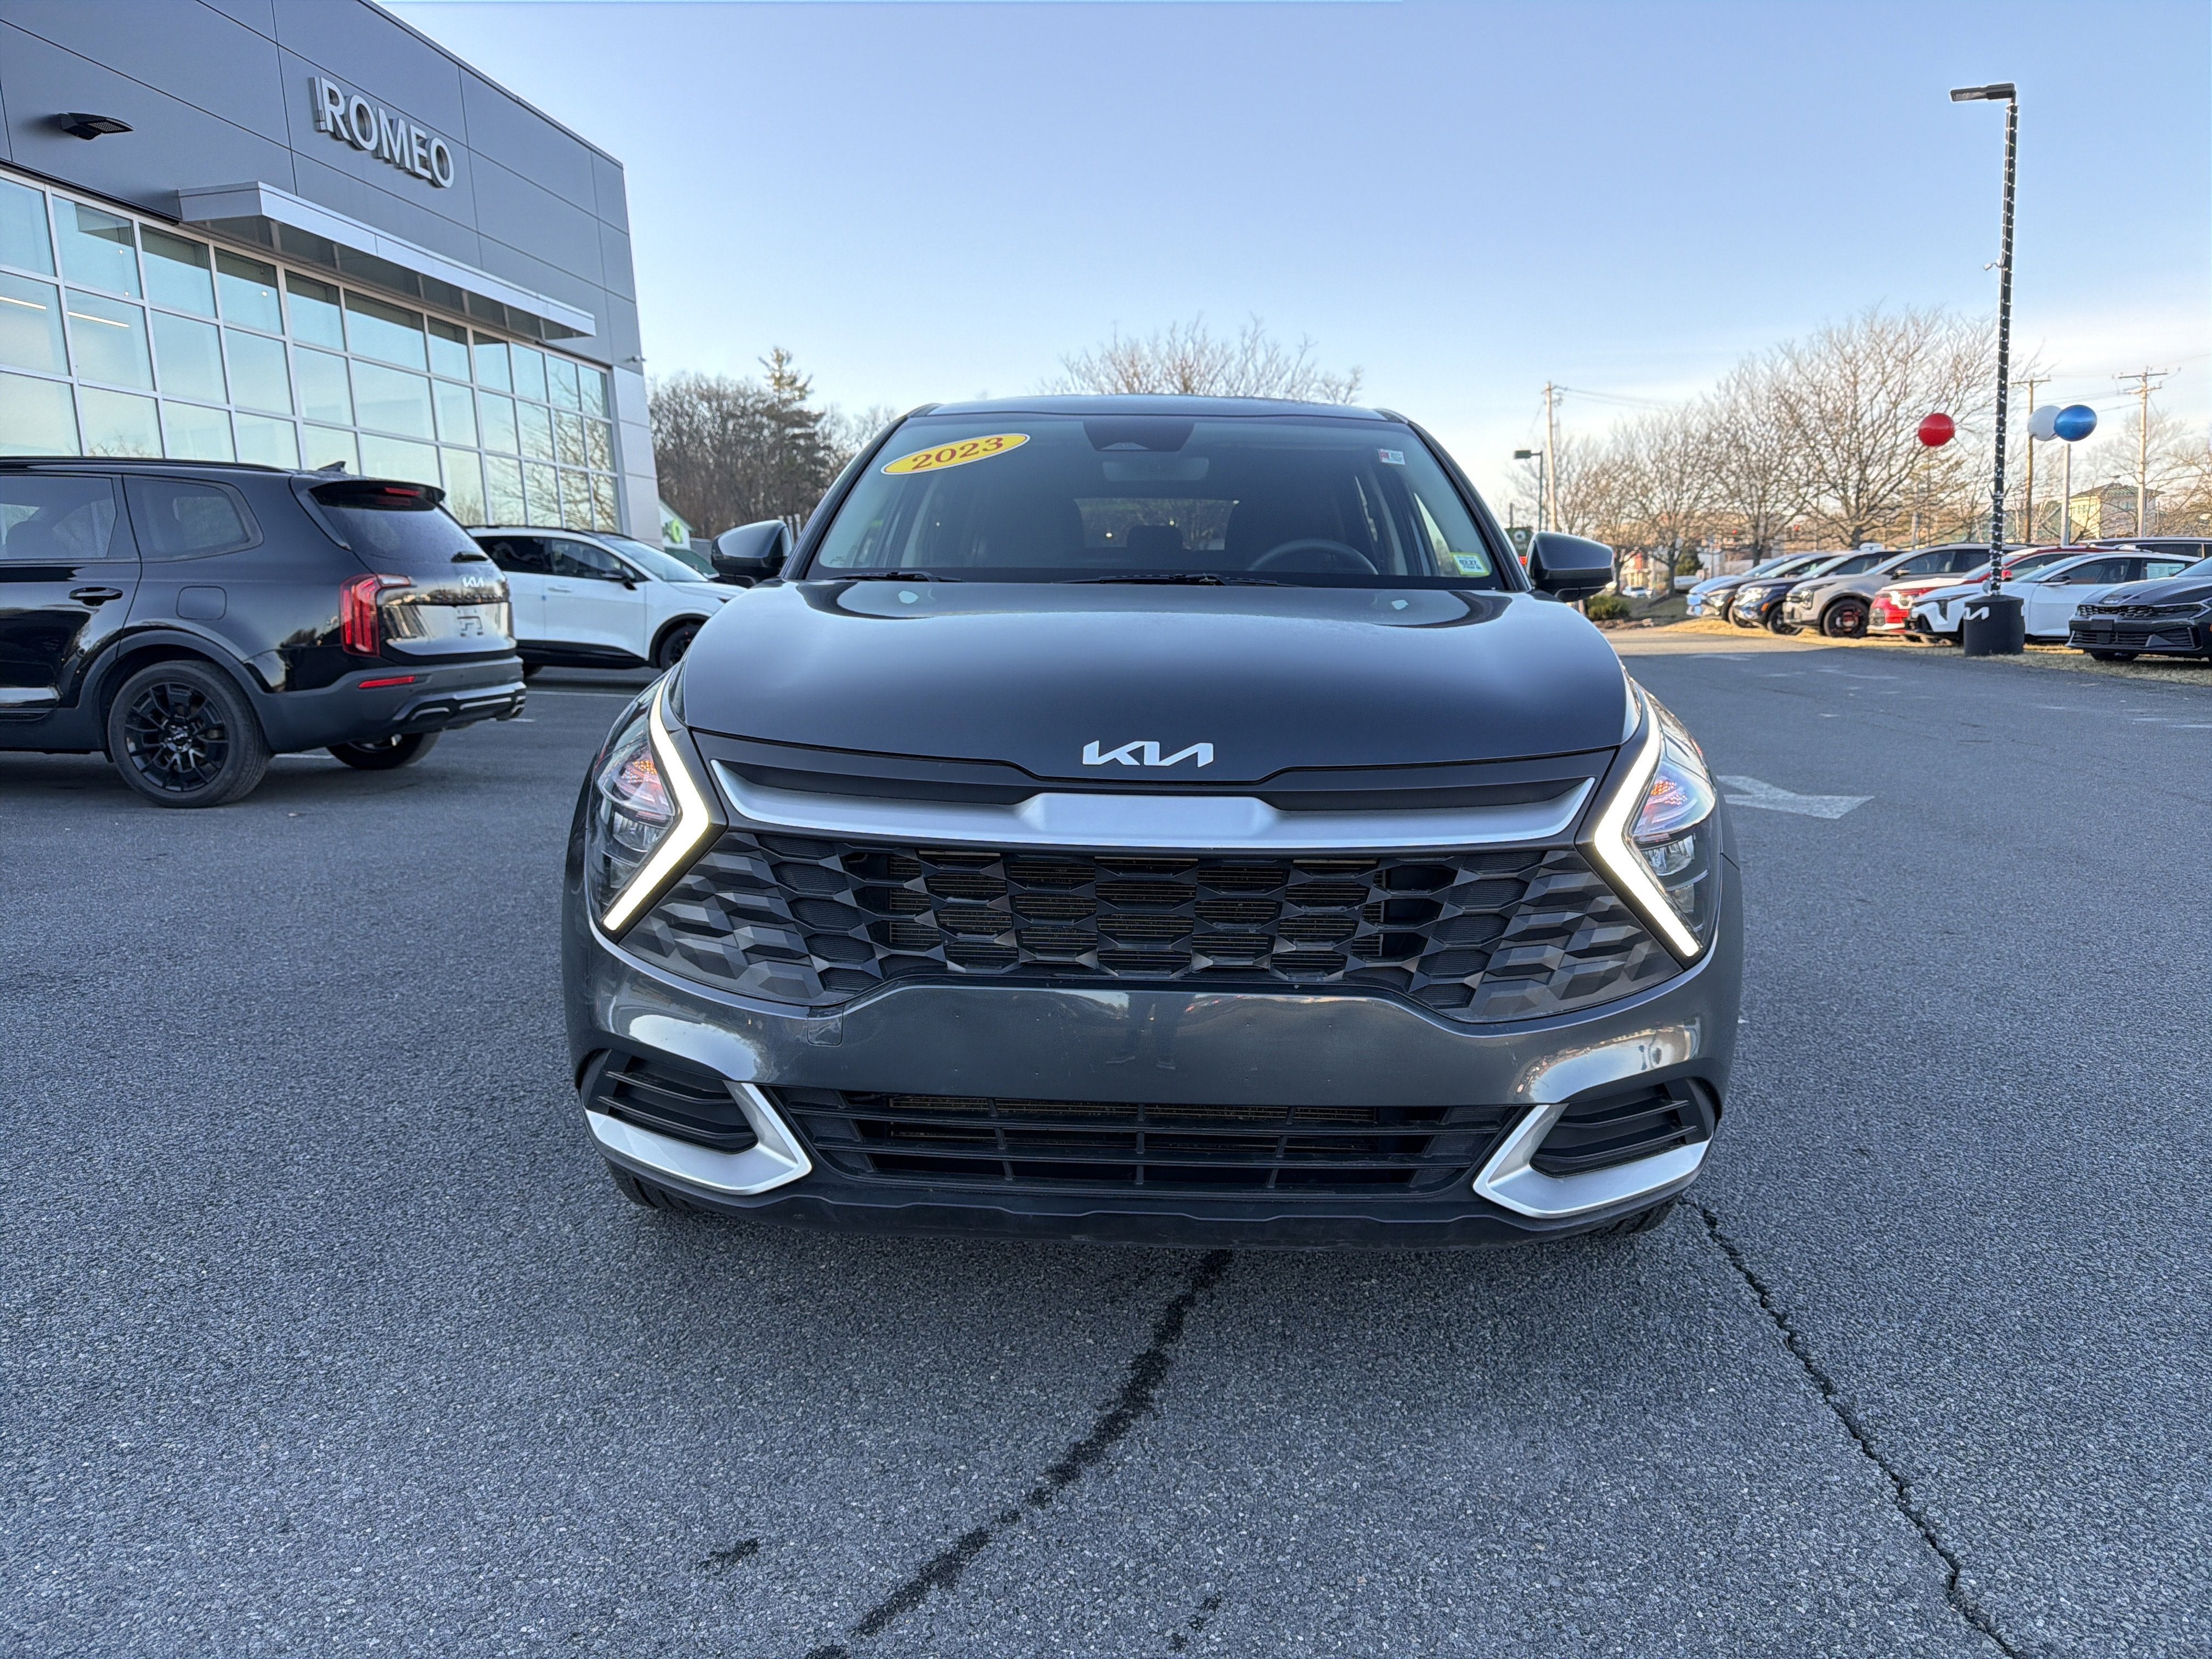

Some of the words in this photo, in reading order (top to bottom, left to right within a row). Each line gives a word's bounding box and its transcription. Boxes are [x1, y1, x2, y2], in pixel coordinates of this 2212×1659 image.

[313, 76, 454, 188] ROMEO
[912, 437, 1003, 470] 2023
[462, 576, 484, 588] KIA
[1082, 740, 1214, 768] KIA
